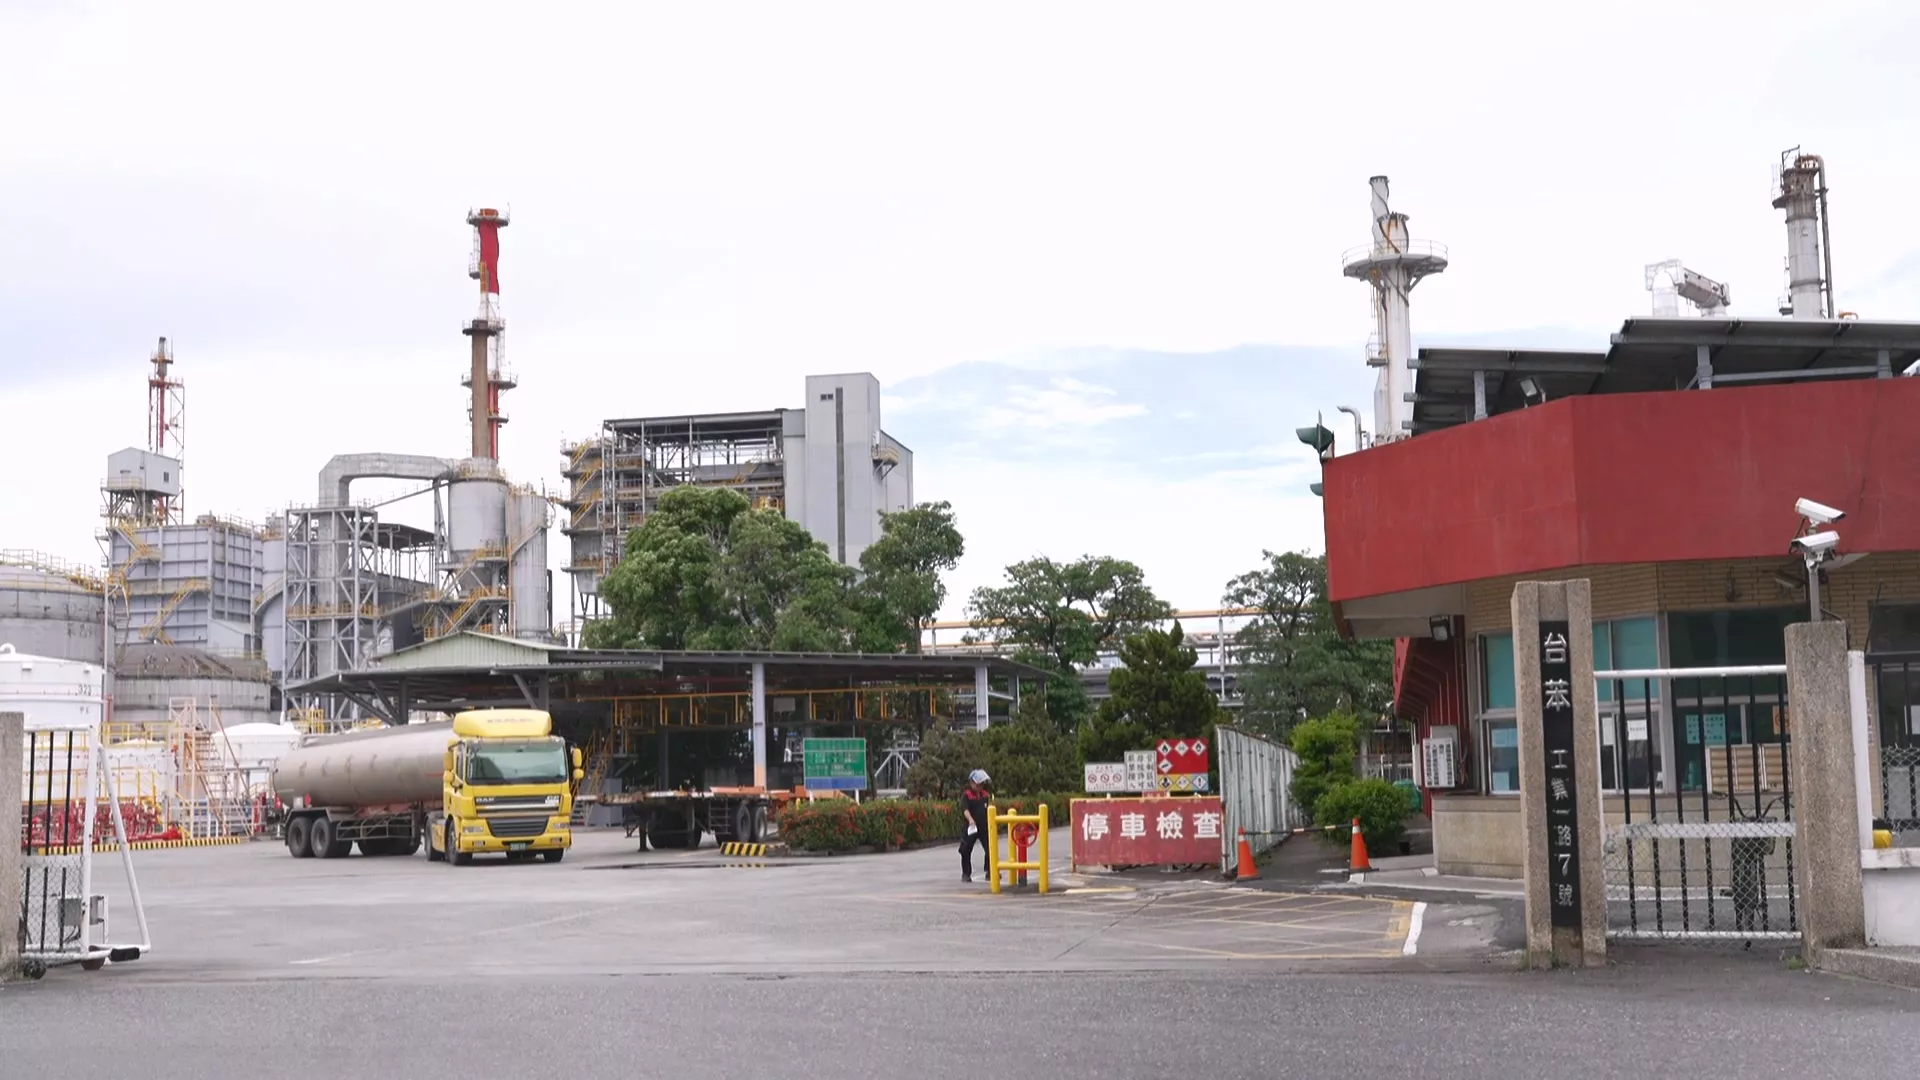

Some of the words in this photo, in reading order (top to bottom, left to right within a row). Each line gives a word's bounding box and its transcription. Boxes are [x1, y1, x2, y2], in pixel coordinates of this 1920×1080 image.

[1544, 632, 1571, 712] 台苯
[1082, 811, 1220, 841] 停車檢查
[1551, 749, 1573, 907] 工業一路7號
